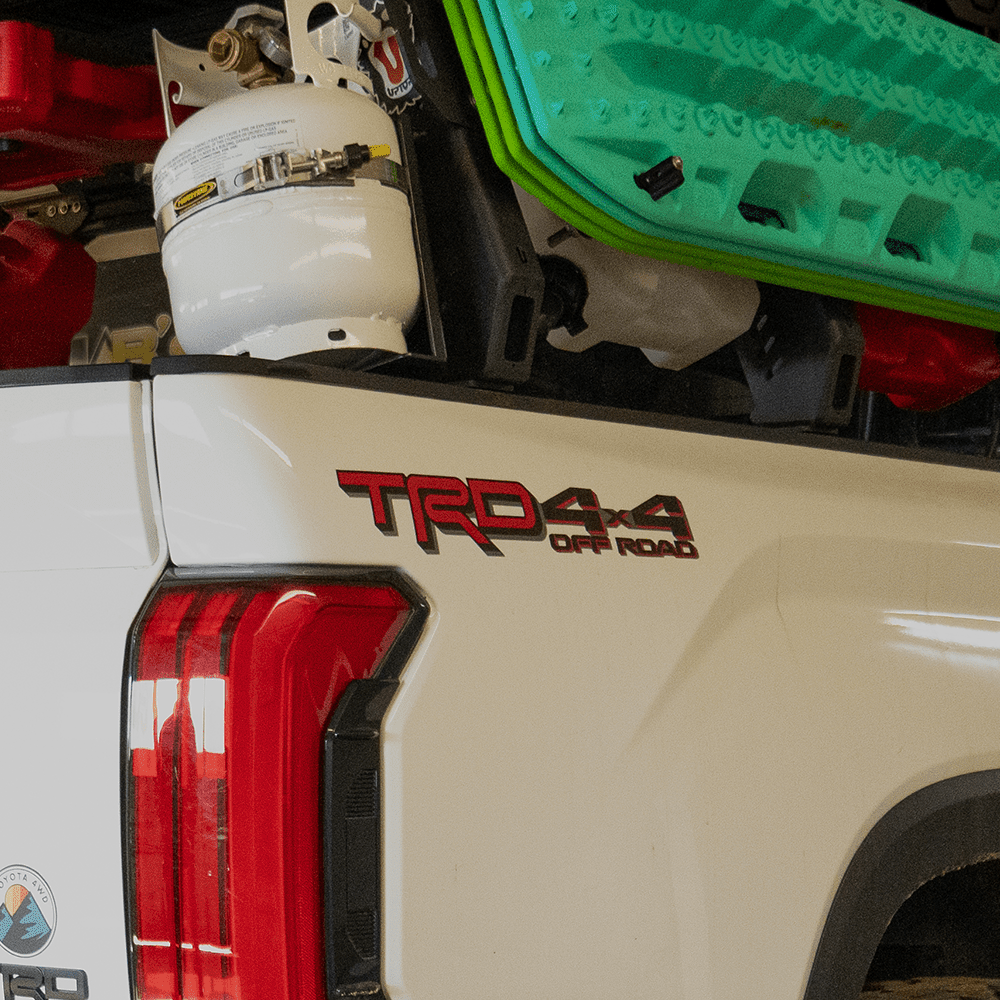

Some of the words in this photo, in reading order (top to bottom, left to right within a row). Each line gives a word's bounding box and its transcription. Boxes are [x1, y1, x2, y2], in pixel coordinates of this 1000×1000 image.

[336, 470, 547, 556] TRD
[550, 534, 613, 555] OFF
[615, 537, 699, 559] ROAD
